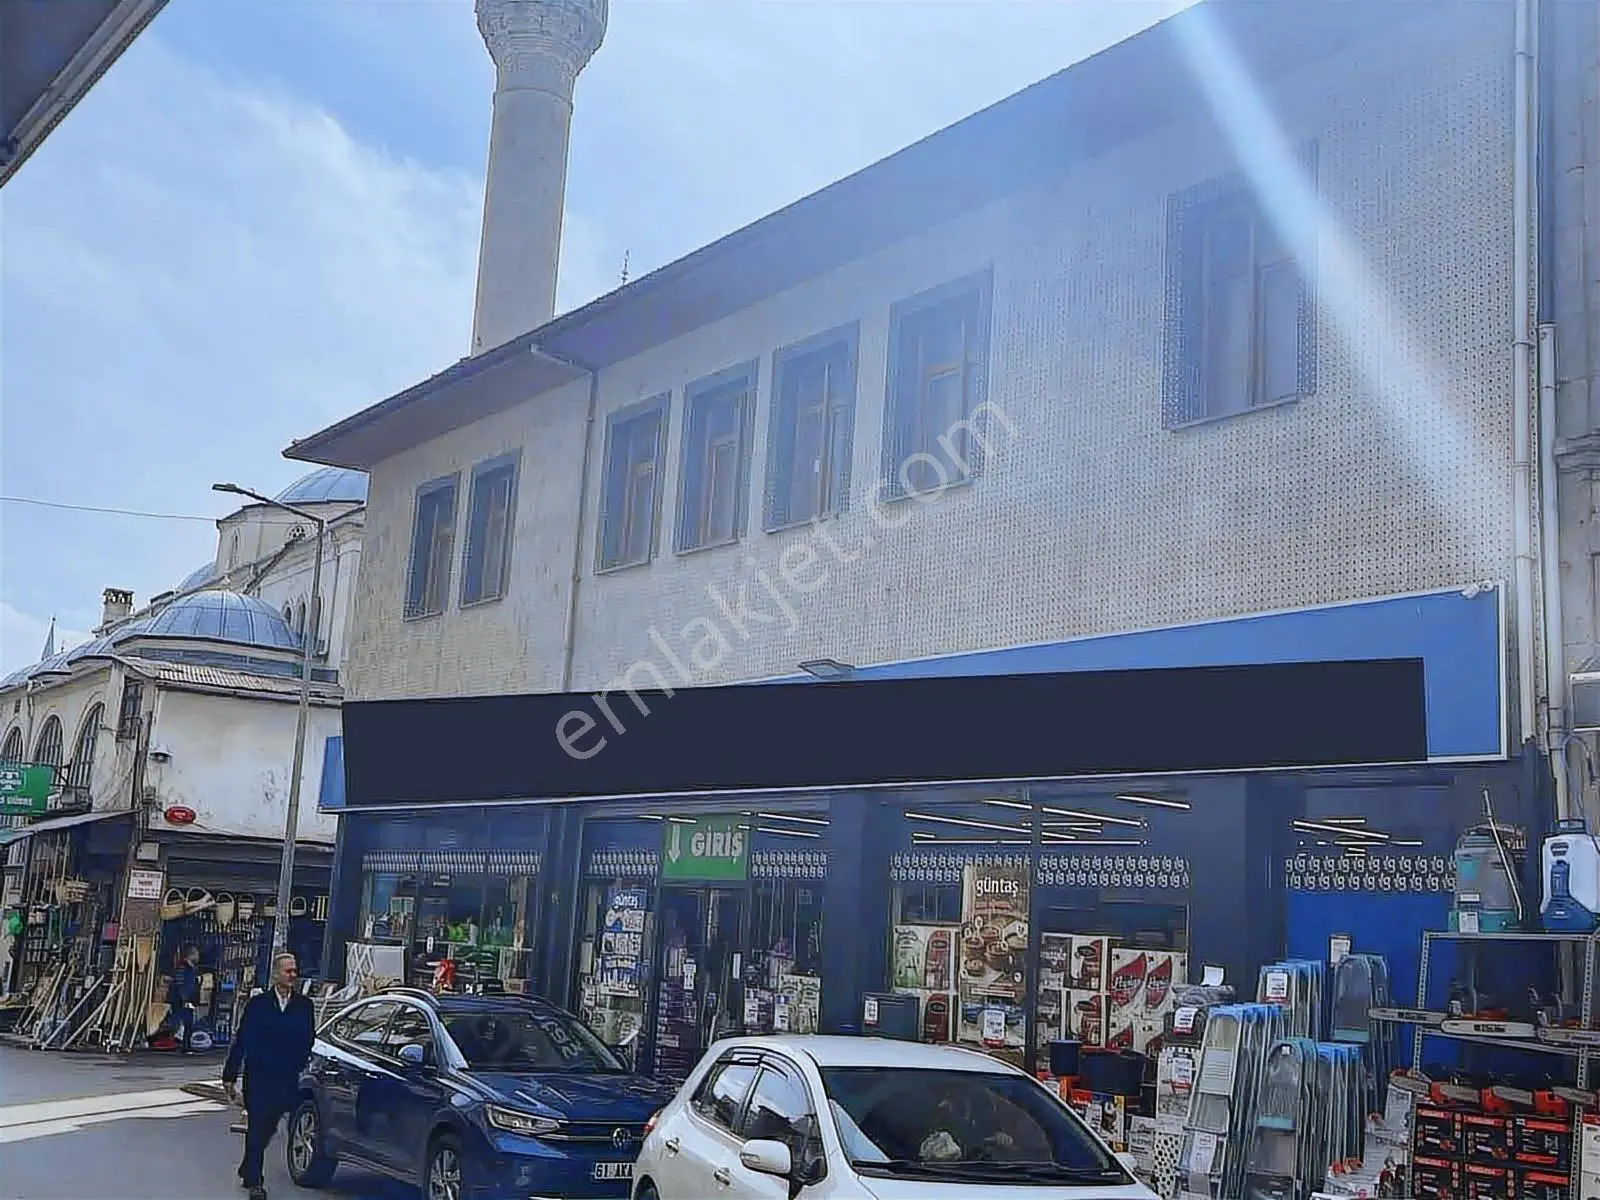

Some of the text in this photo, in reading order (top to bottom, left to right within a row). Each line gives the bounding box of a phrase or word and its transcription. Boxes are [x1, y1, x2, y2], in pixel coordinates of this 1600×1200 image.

[690, 824, 744, 865] GİRİŞ
[976, 876, 1019, 898] güntaş
[596, 1164, 608, 1178] 61
